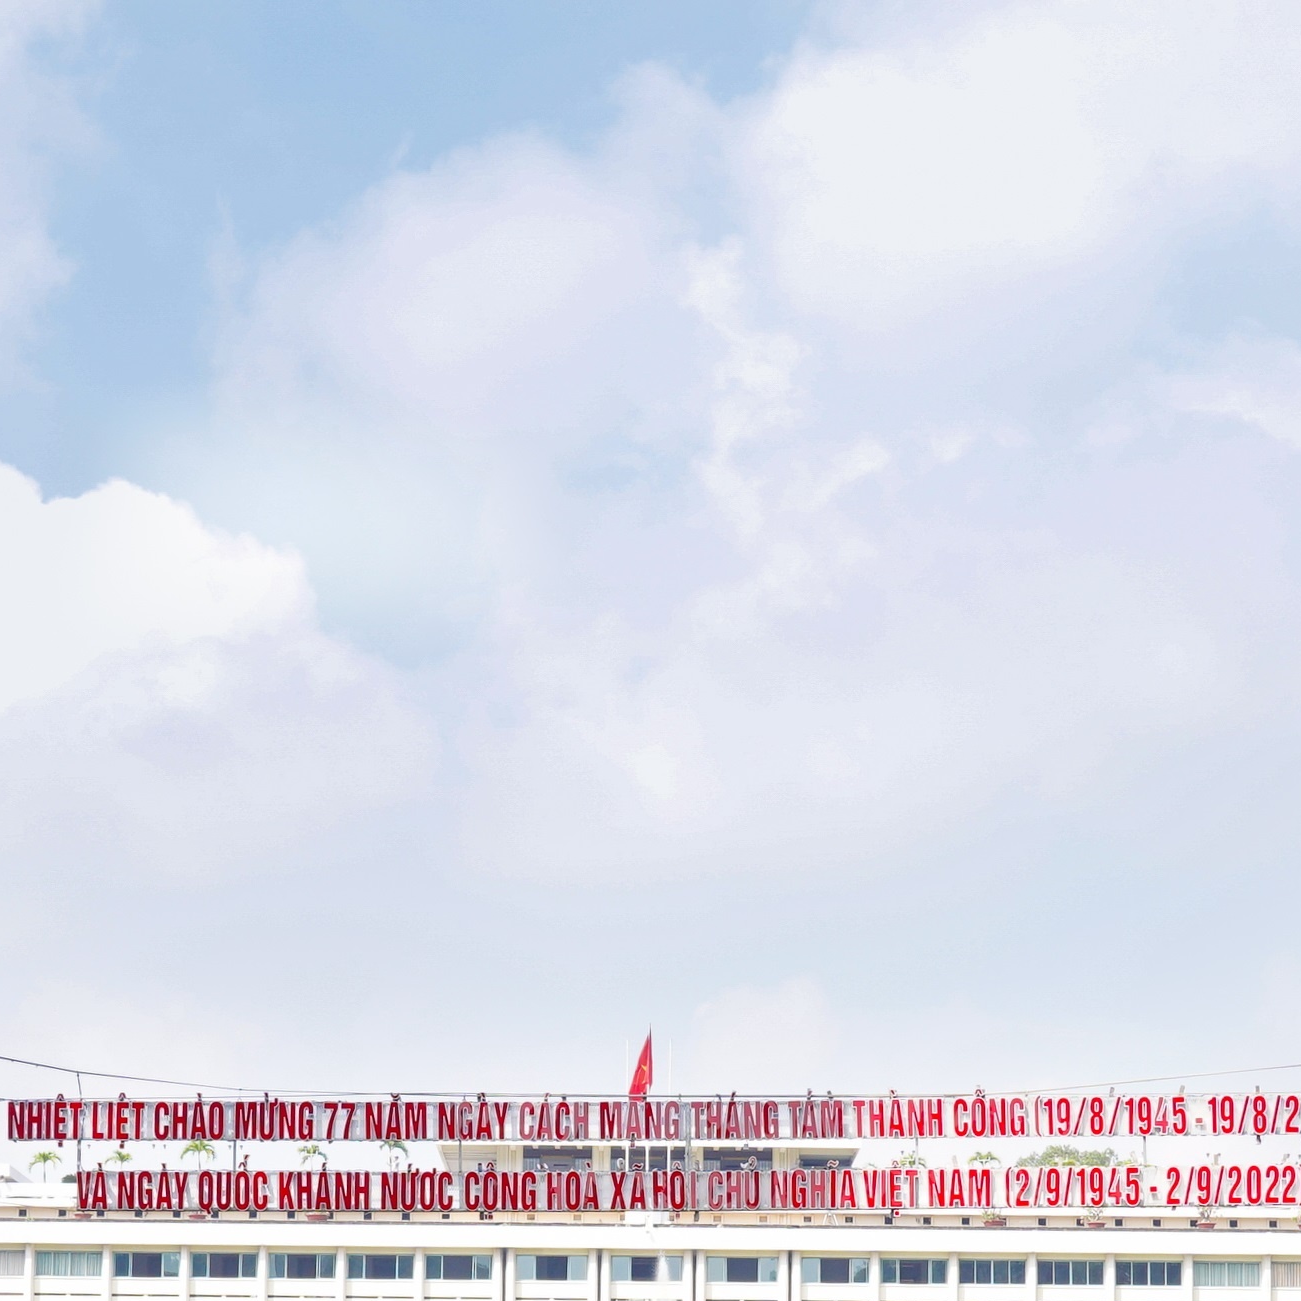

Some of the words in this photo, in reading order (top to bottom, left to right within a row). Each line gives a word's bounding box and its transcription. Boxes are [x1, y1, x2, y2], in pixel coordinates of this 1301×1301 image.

[7, 1093, 84, 1147] NHIỆT
[91, 1092, 146, 1149] LIỆT
[154, 1093, 225, 1141] CHÀO
[234, 1092, 315, 1141] MỪNG
[323, 1101, 357, 1141] 77
[365, 1092, 428, 1141] NĂM
[437, 1092, 510, 1141] NGÀY
[518, 1092, 590, 1141] CÁCH
[599, 1100, 681, 1148] MẠNG
[690, 1091, 779, 1140] THÁNG
[787, 1089, 844, 1139] TÁM
[852, 1089, 945, 1138] THÀNH
[953, 1088, 1026, 1138] CÔNG
[1034, 1094, 1188, 1138] (19/8/1945
[76, 1162, 108, 1210] VÀ
[117, 1162, 189, 1211] NGÀY
[198, 1154, 269, 1215] QUỐC
[278, 1162, 371, 1211] KHÁNH
[381, 1162, 454, 1212] NƯỚC
[464, 1161, 537, 1220] CỘNG
[548, 1161, 600, 1211] HOÀ
[610, 1161, 647, 1211] XÃ
[652, 1160, 698, 1219] HỘI
[707, 1156, 760, 1211] CHỦ
[770, 1160, 857, 1209] NGHĨA
[862, 1160, 918, 1217] VIỆT
[927, 1168, 991, 1208] NAM
[1004, 1166, 1140, 1208] (2/9/1945
